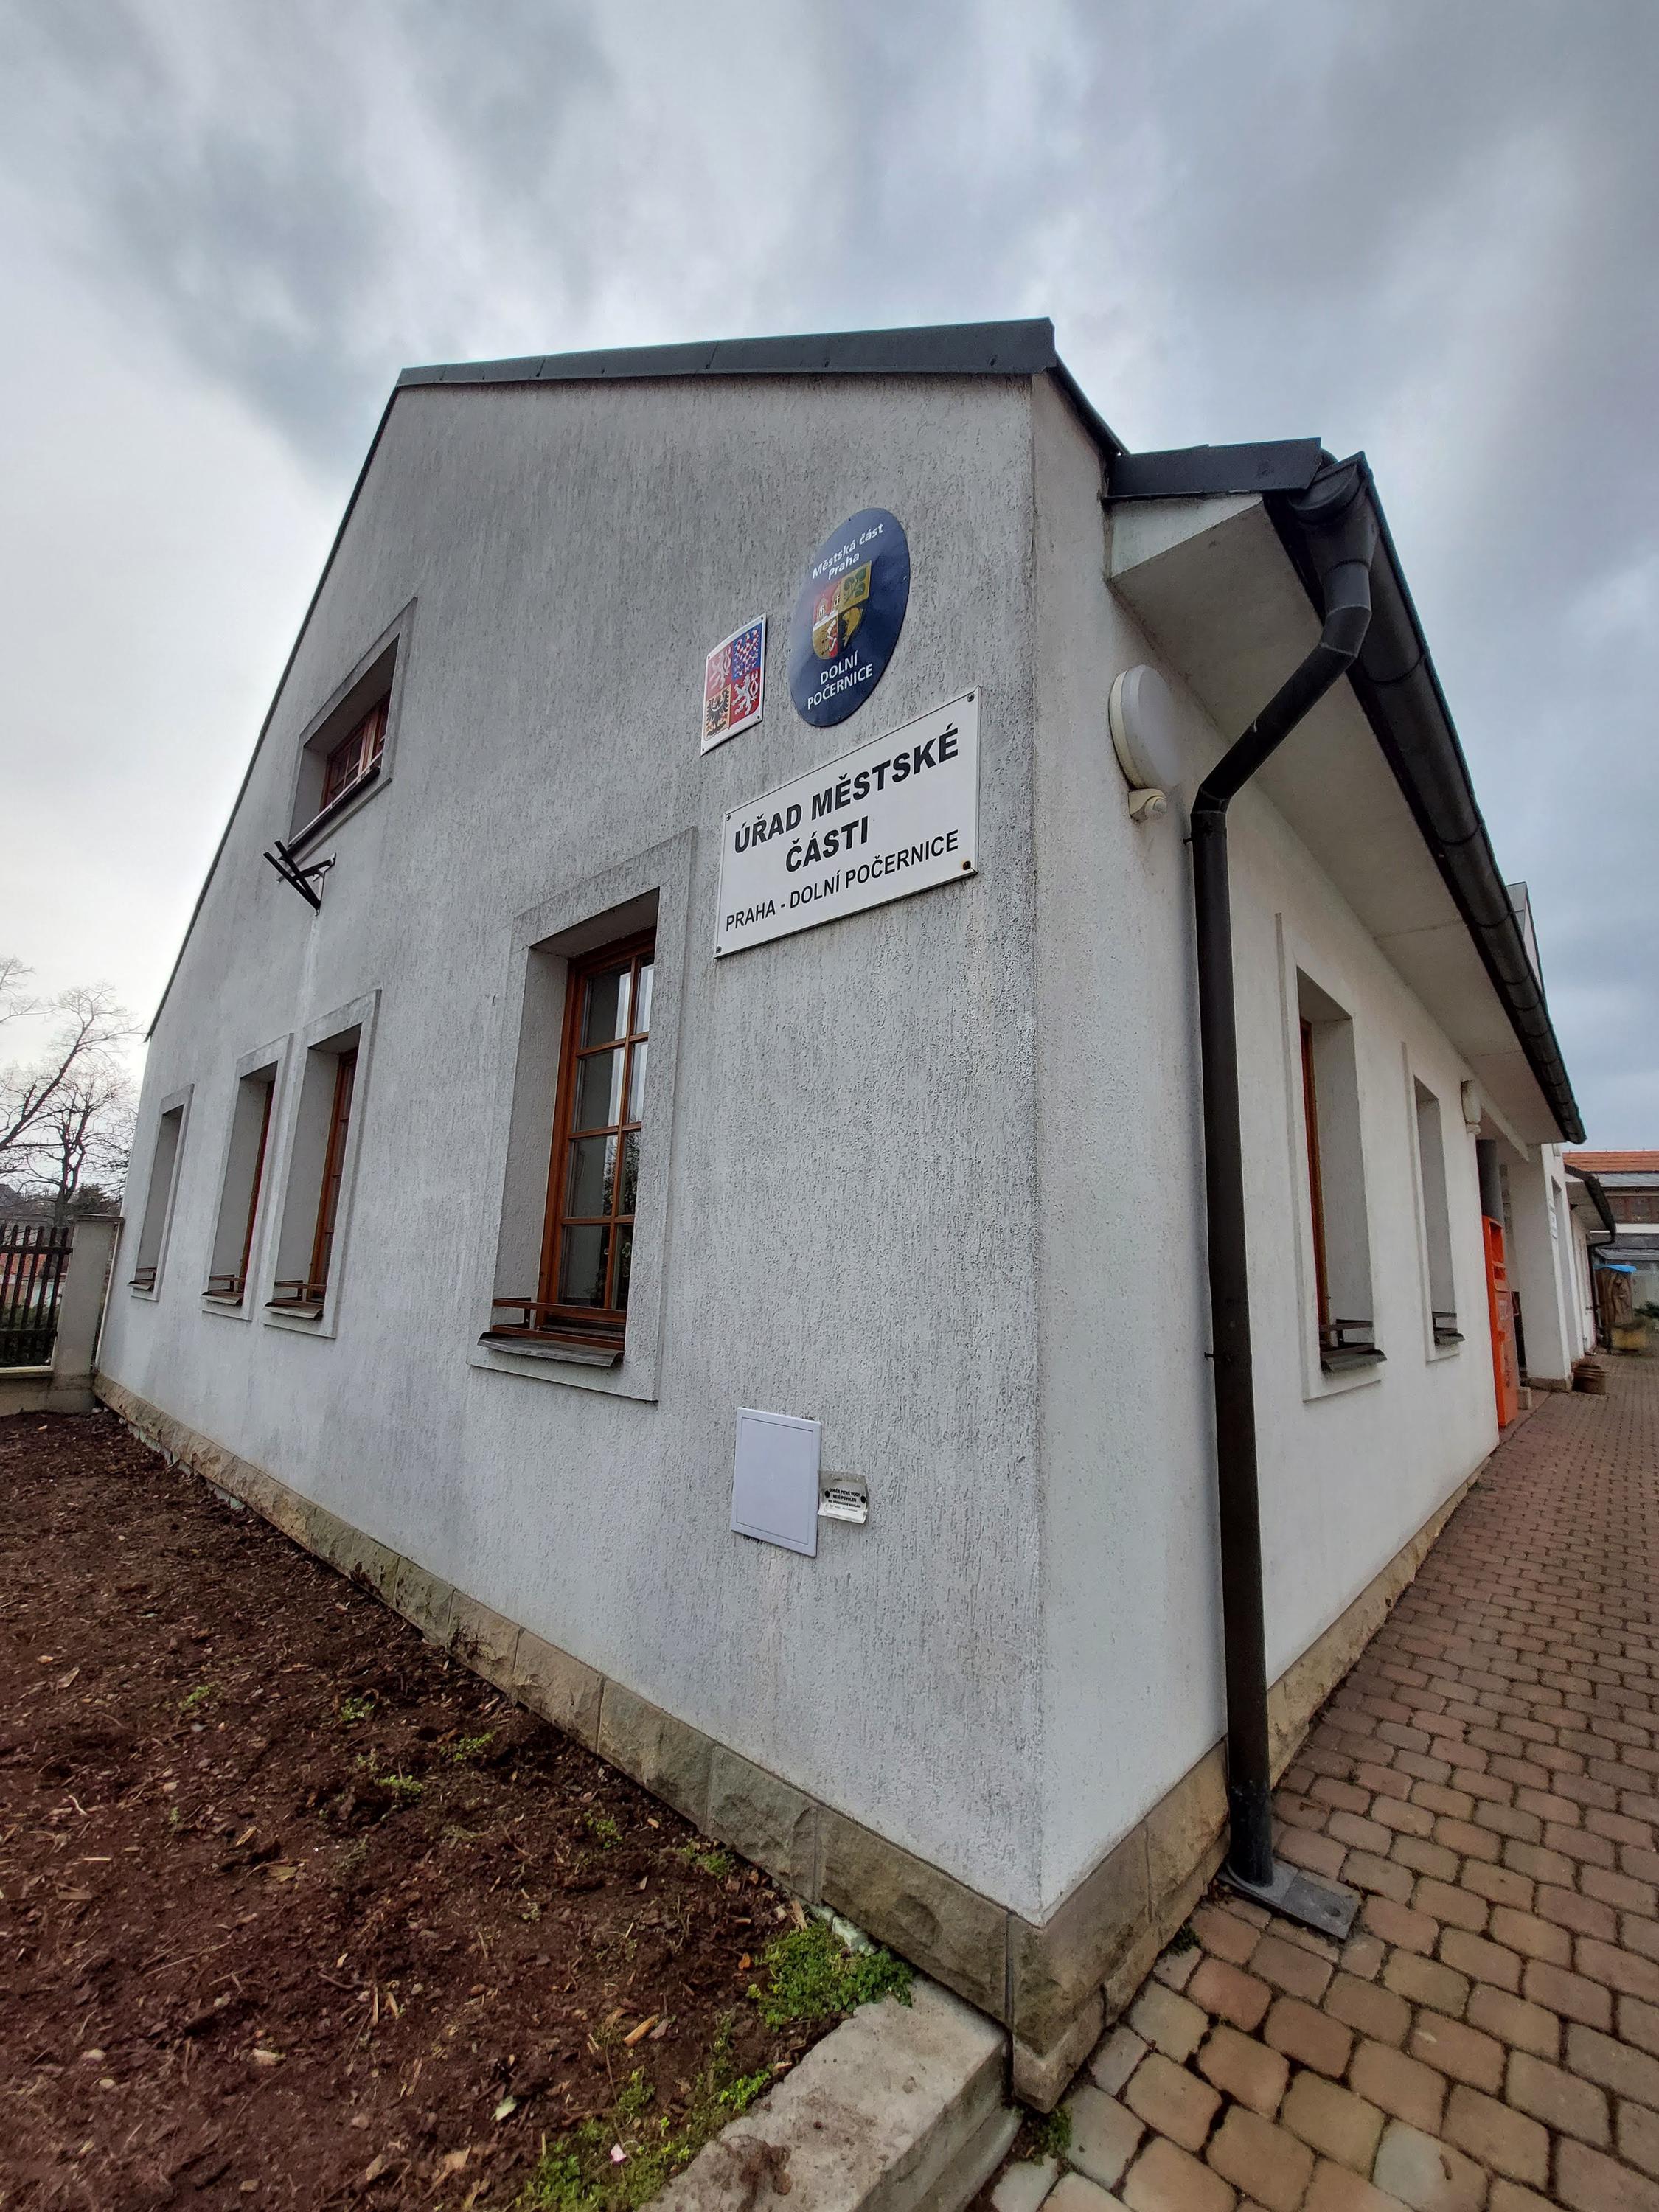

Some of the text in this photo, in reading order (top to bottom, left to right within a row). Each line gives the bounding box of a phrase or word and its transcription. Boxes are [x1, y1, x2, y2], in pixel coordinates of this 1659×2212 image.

[813, 523, 883, 579] Městská část
[828, 553, 860, 580] Praha
[807, 663, 873, 710] POČERNICE
[821, 650, 858, 685] DOLNÍ
[734, 722, 959, 854] ÚŘAD MĚSTSKÉ
[785, 815, 869, 873] ČÁSTI
[726, 900, 776, 932] PRAHA
[790, 869, 841, 909] DOLNÍ
[846, 830, 959, 889] POČERNICE
